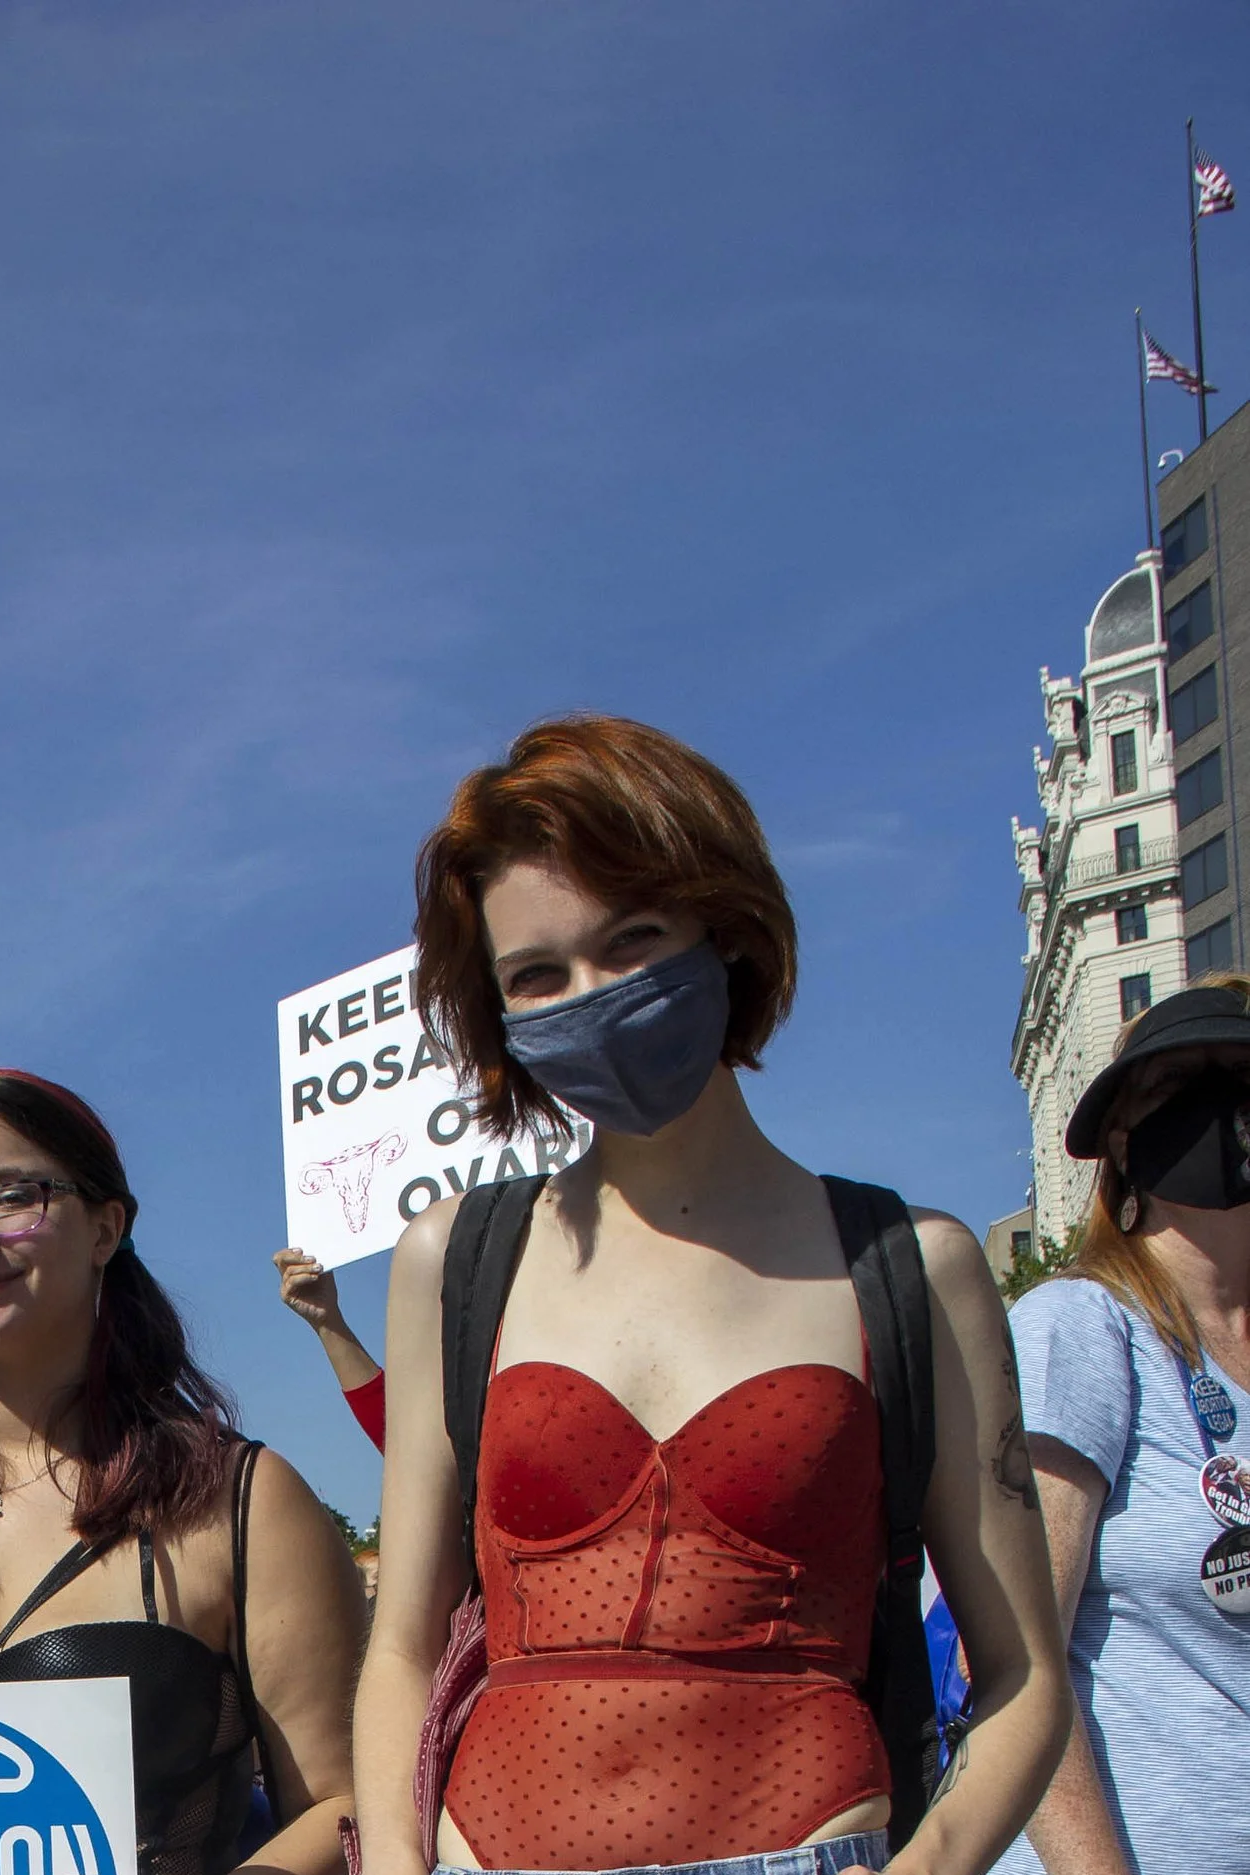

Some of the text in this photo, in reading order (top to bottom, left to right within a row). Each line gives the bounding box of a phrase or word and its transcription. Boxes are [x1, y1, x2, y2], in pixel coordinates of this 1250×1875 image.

[1207, 1485, 1226, 1500] Get
[1206, 1557, 1226, 1576] NO
[1214, 1577, 1234, 1596] NO
